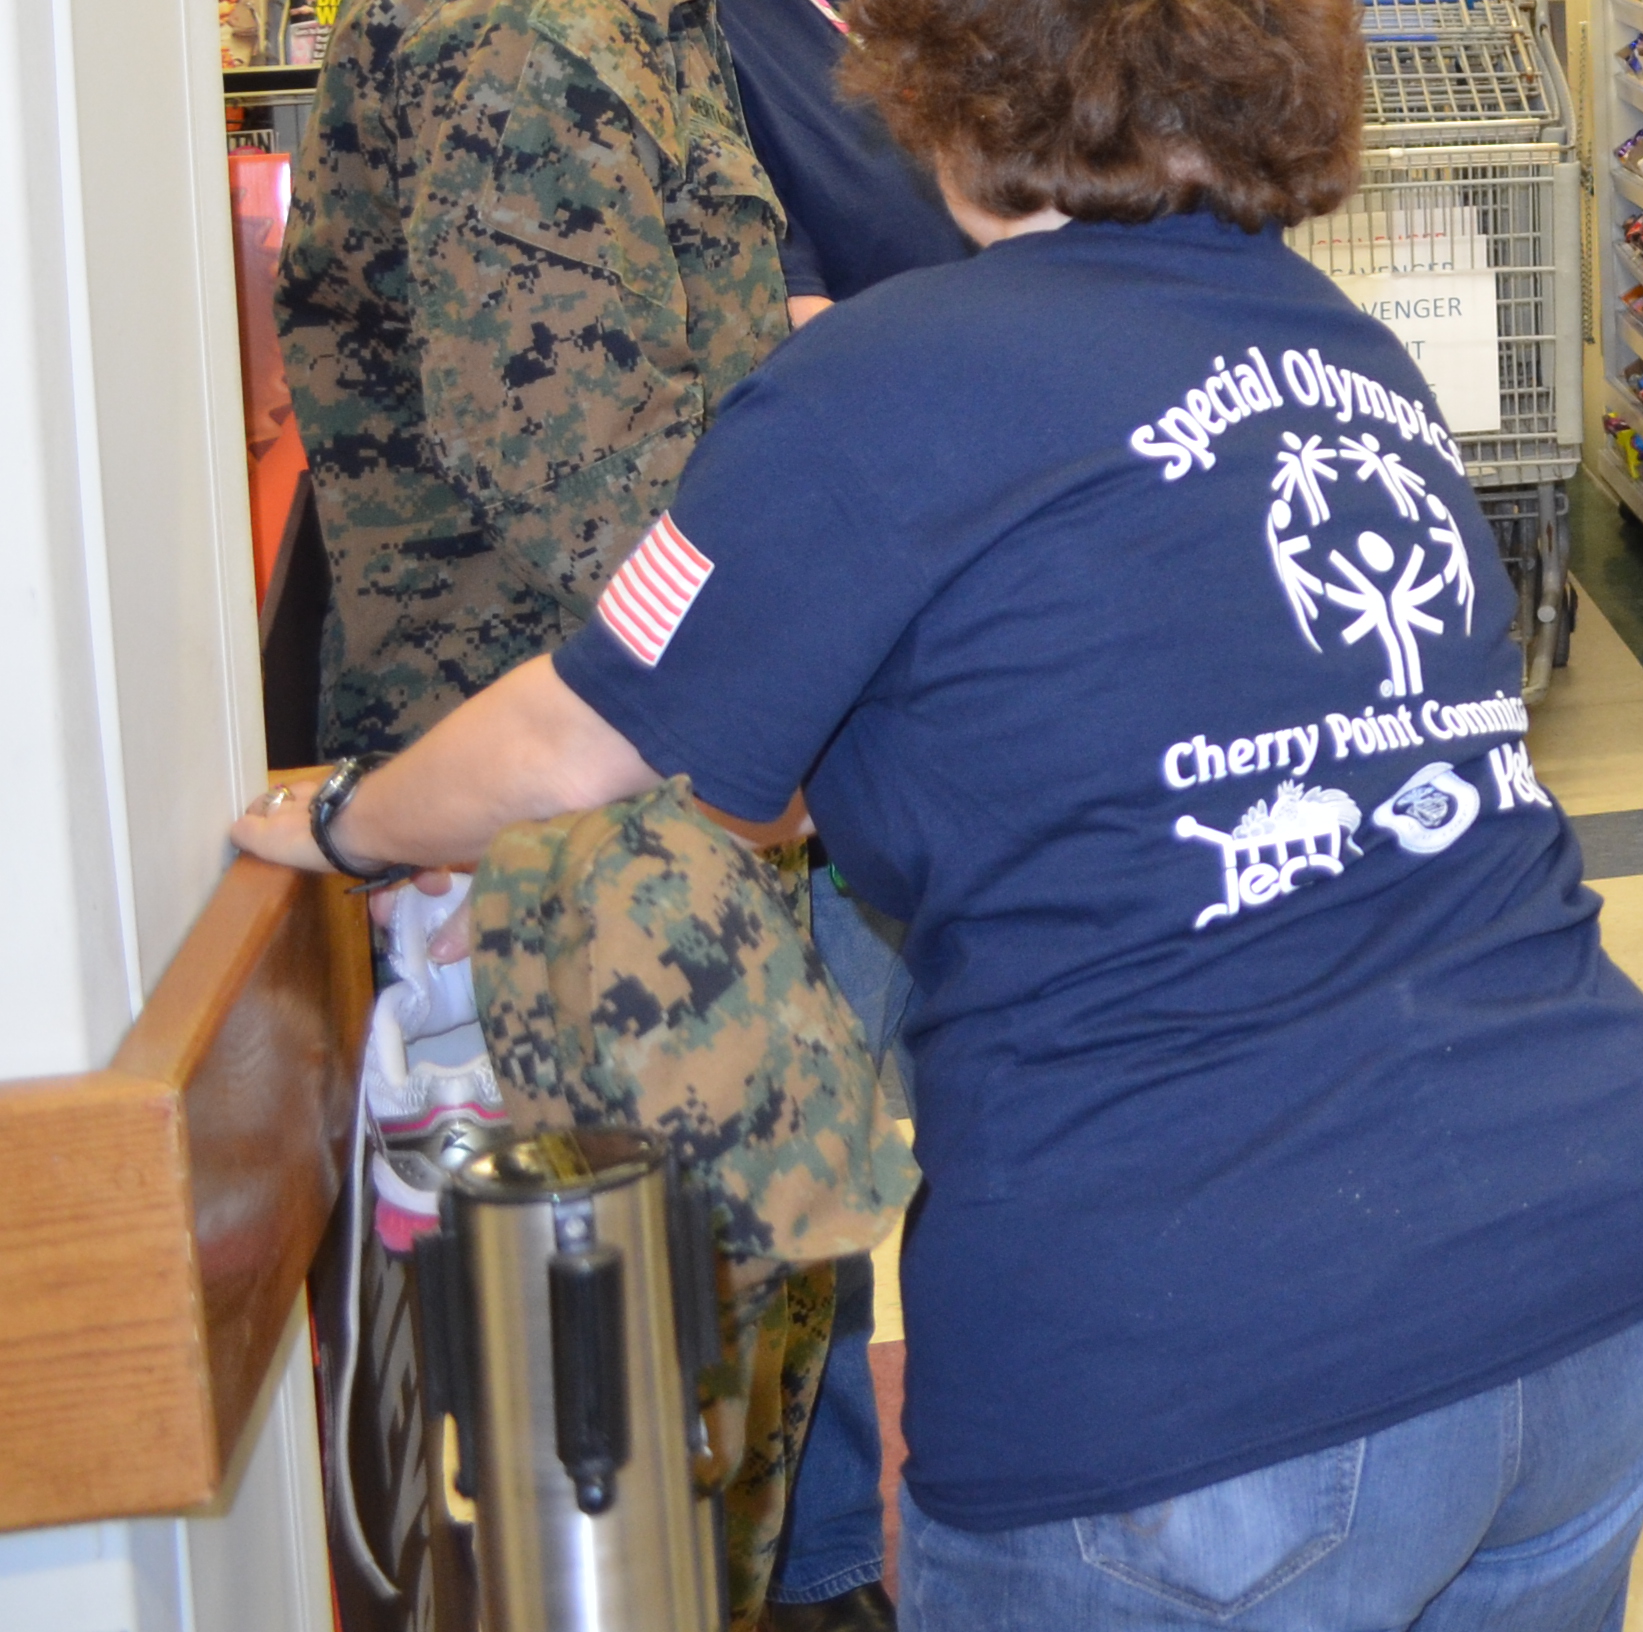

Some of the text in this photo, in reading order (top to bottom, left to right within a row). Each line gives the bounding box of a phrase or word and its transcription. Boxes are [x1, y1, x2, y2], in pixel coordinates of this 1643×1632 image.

[1361, 297, 1463, 320] VENGER
[1130, 345, 1285, 481] Special
[1162, 723, 1320, 790] Cherry
[1325, 704, 1425, 760] Point
